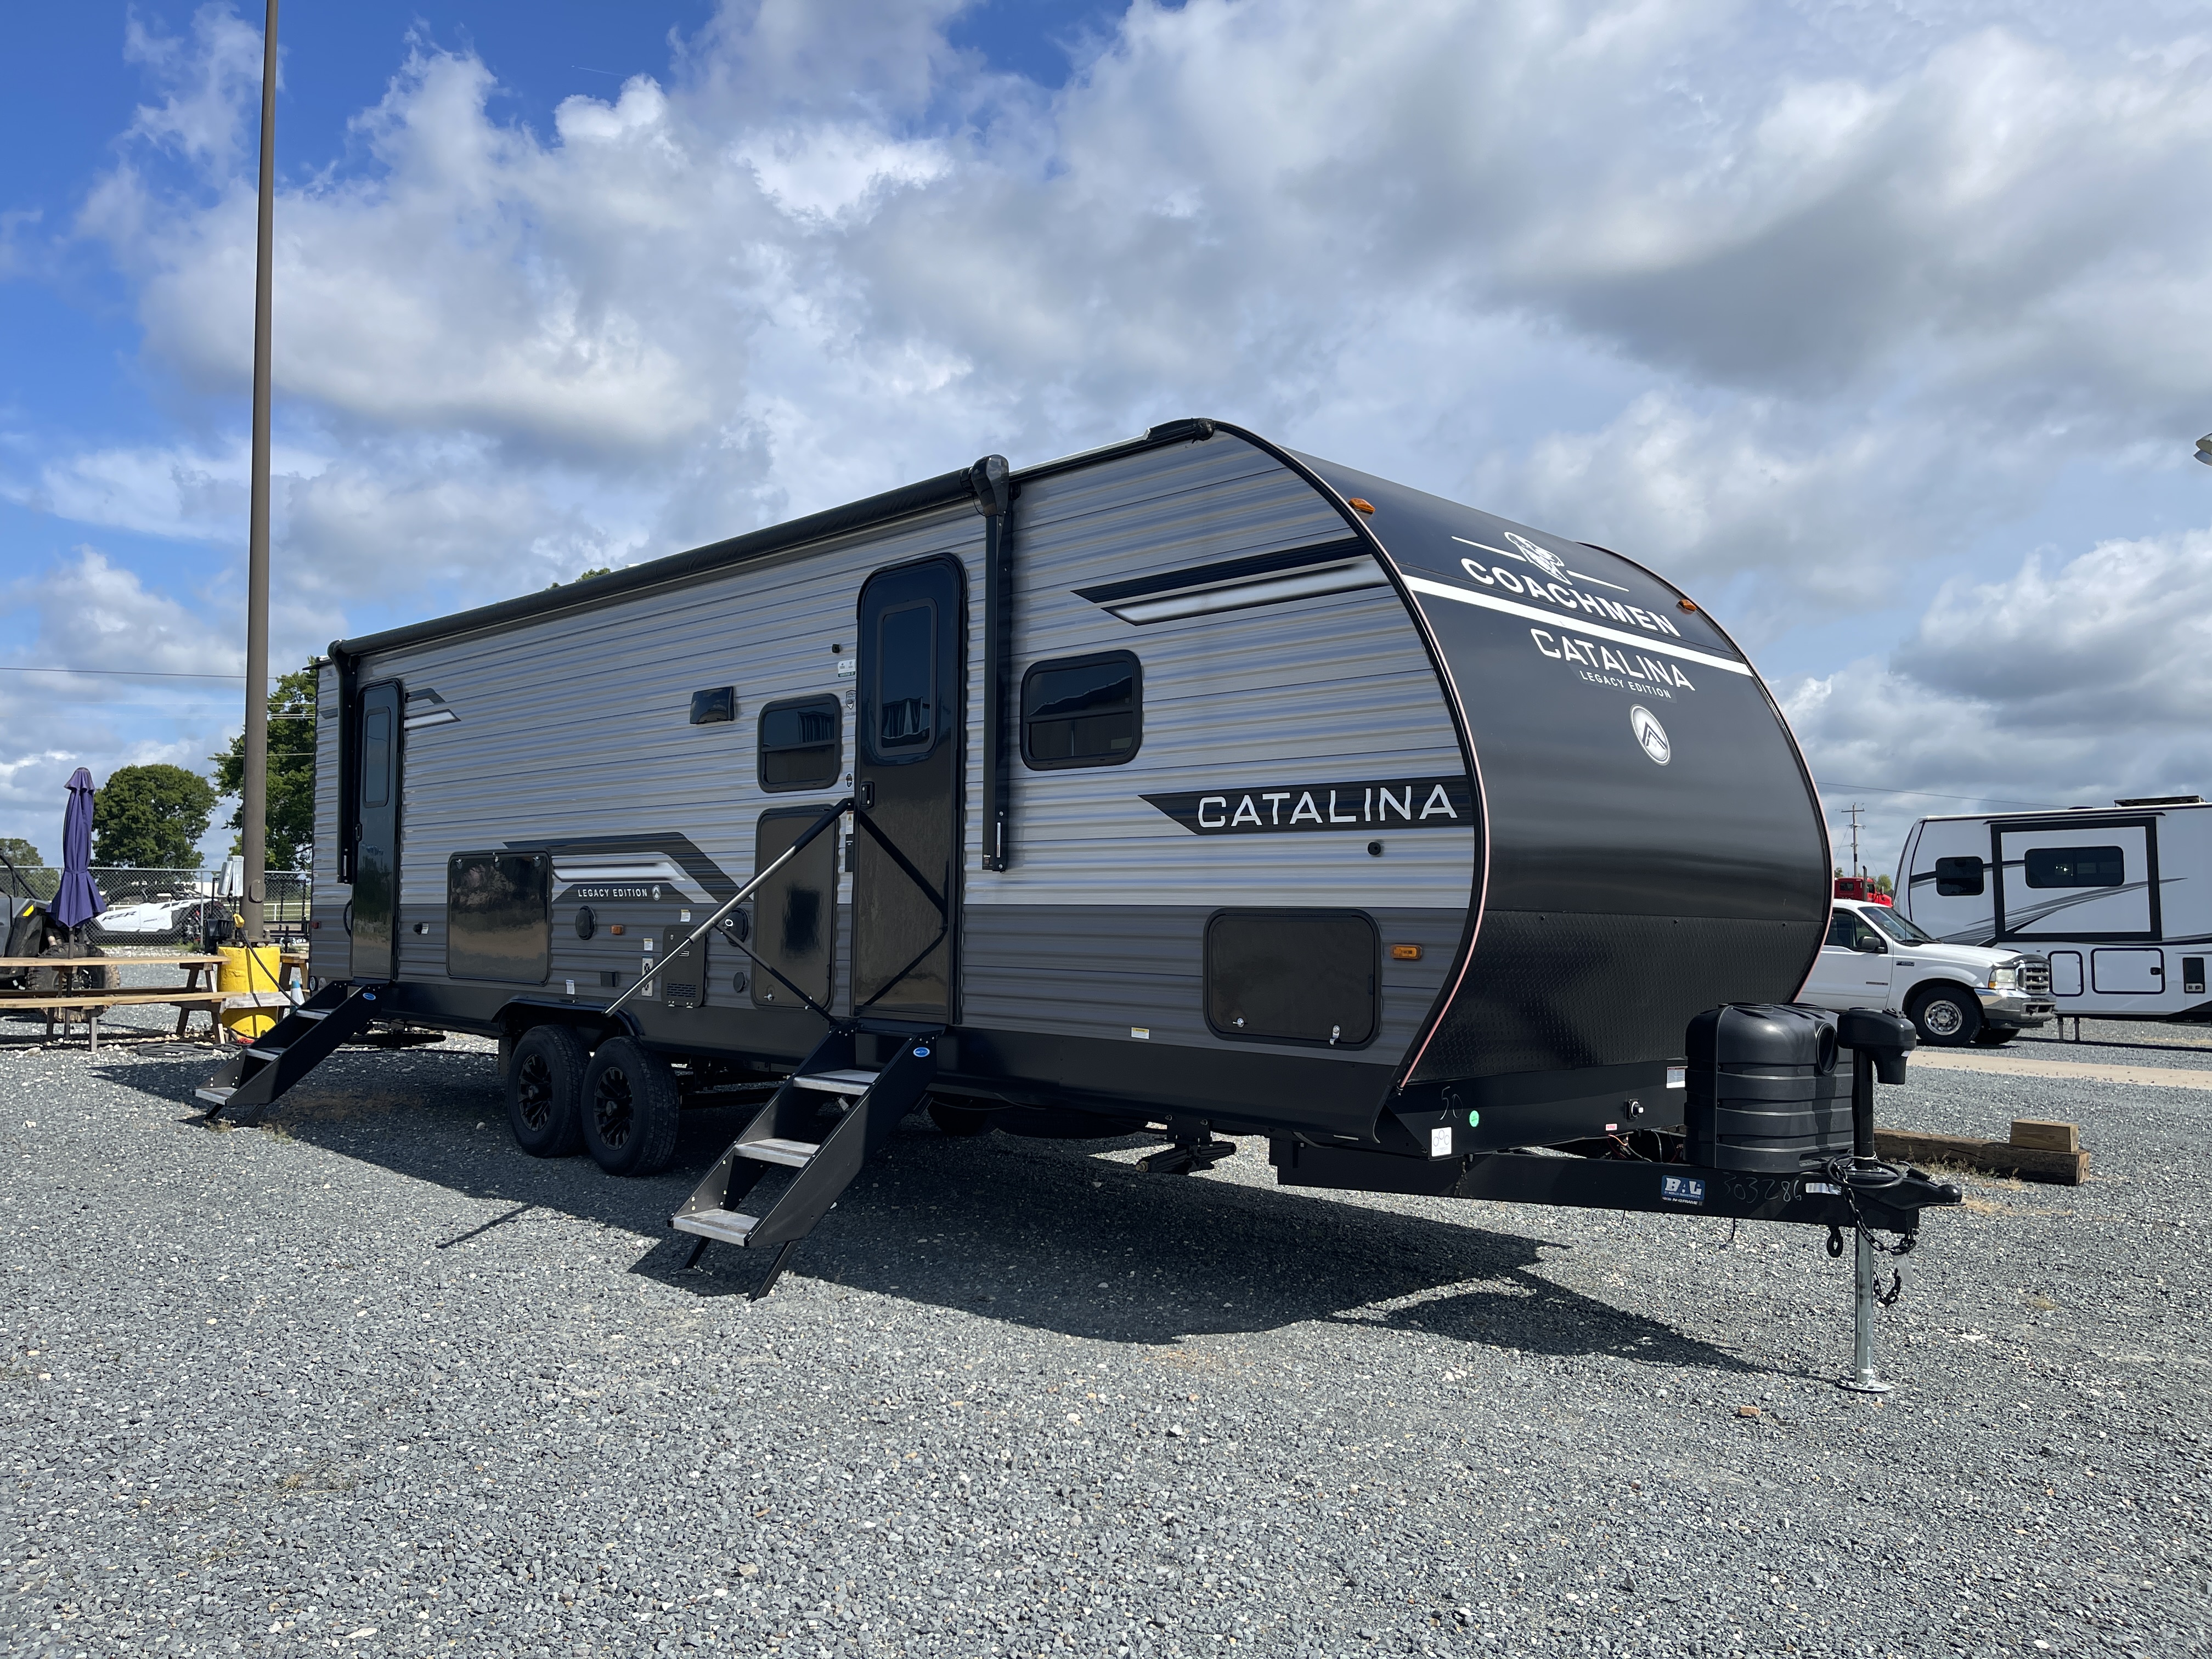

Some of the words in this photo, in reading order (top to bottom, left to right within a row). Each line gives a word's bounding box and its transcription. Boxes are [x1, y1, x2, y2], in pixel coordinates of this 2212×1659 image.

[1460, 557, 1681, 637] COACHMEN
[1530, 628, 1696, 691] CATALINA
[1579, 670, 1624, 689] LEGACY
[1629, 681, 1672, 699] EDITION
[1198, 784, 1458, 828] CATALINA
[577, 888, 610, 898] LEGACY
[613, 888, 647, 898] EDITION
